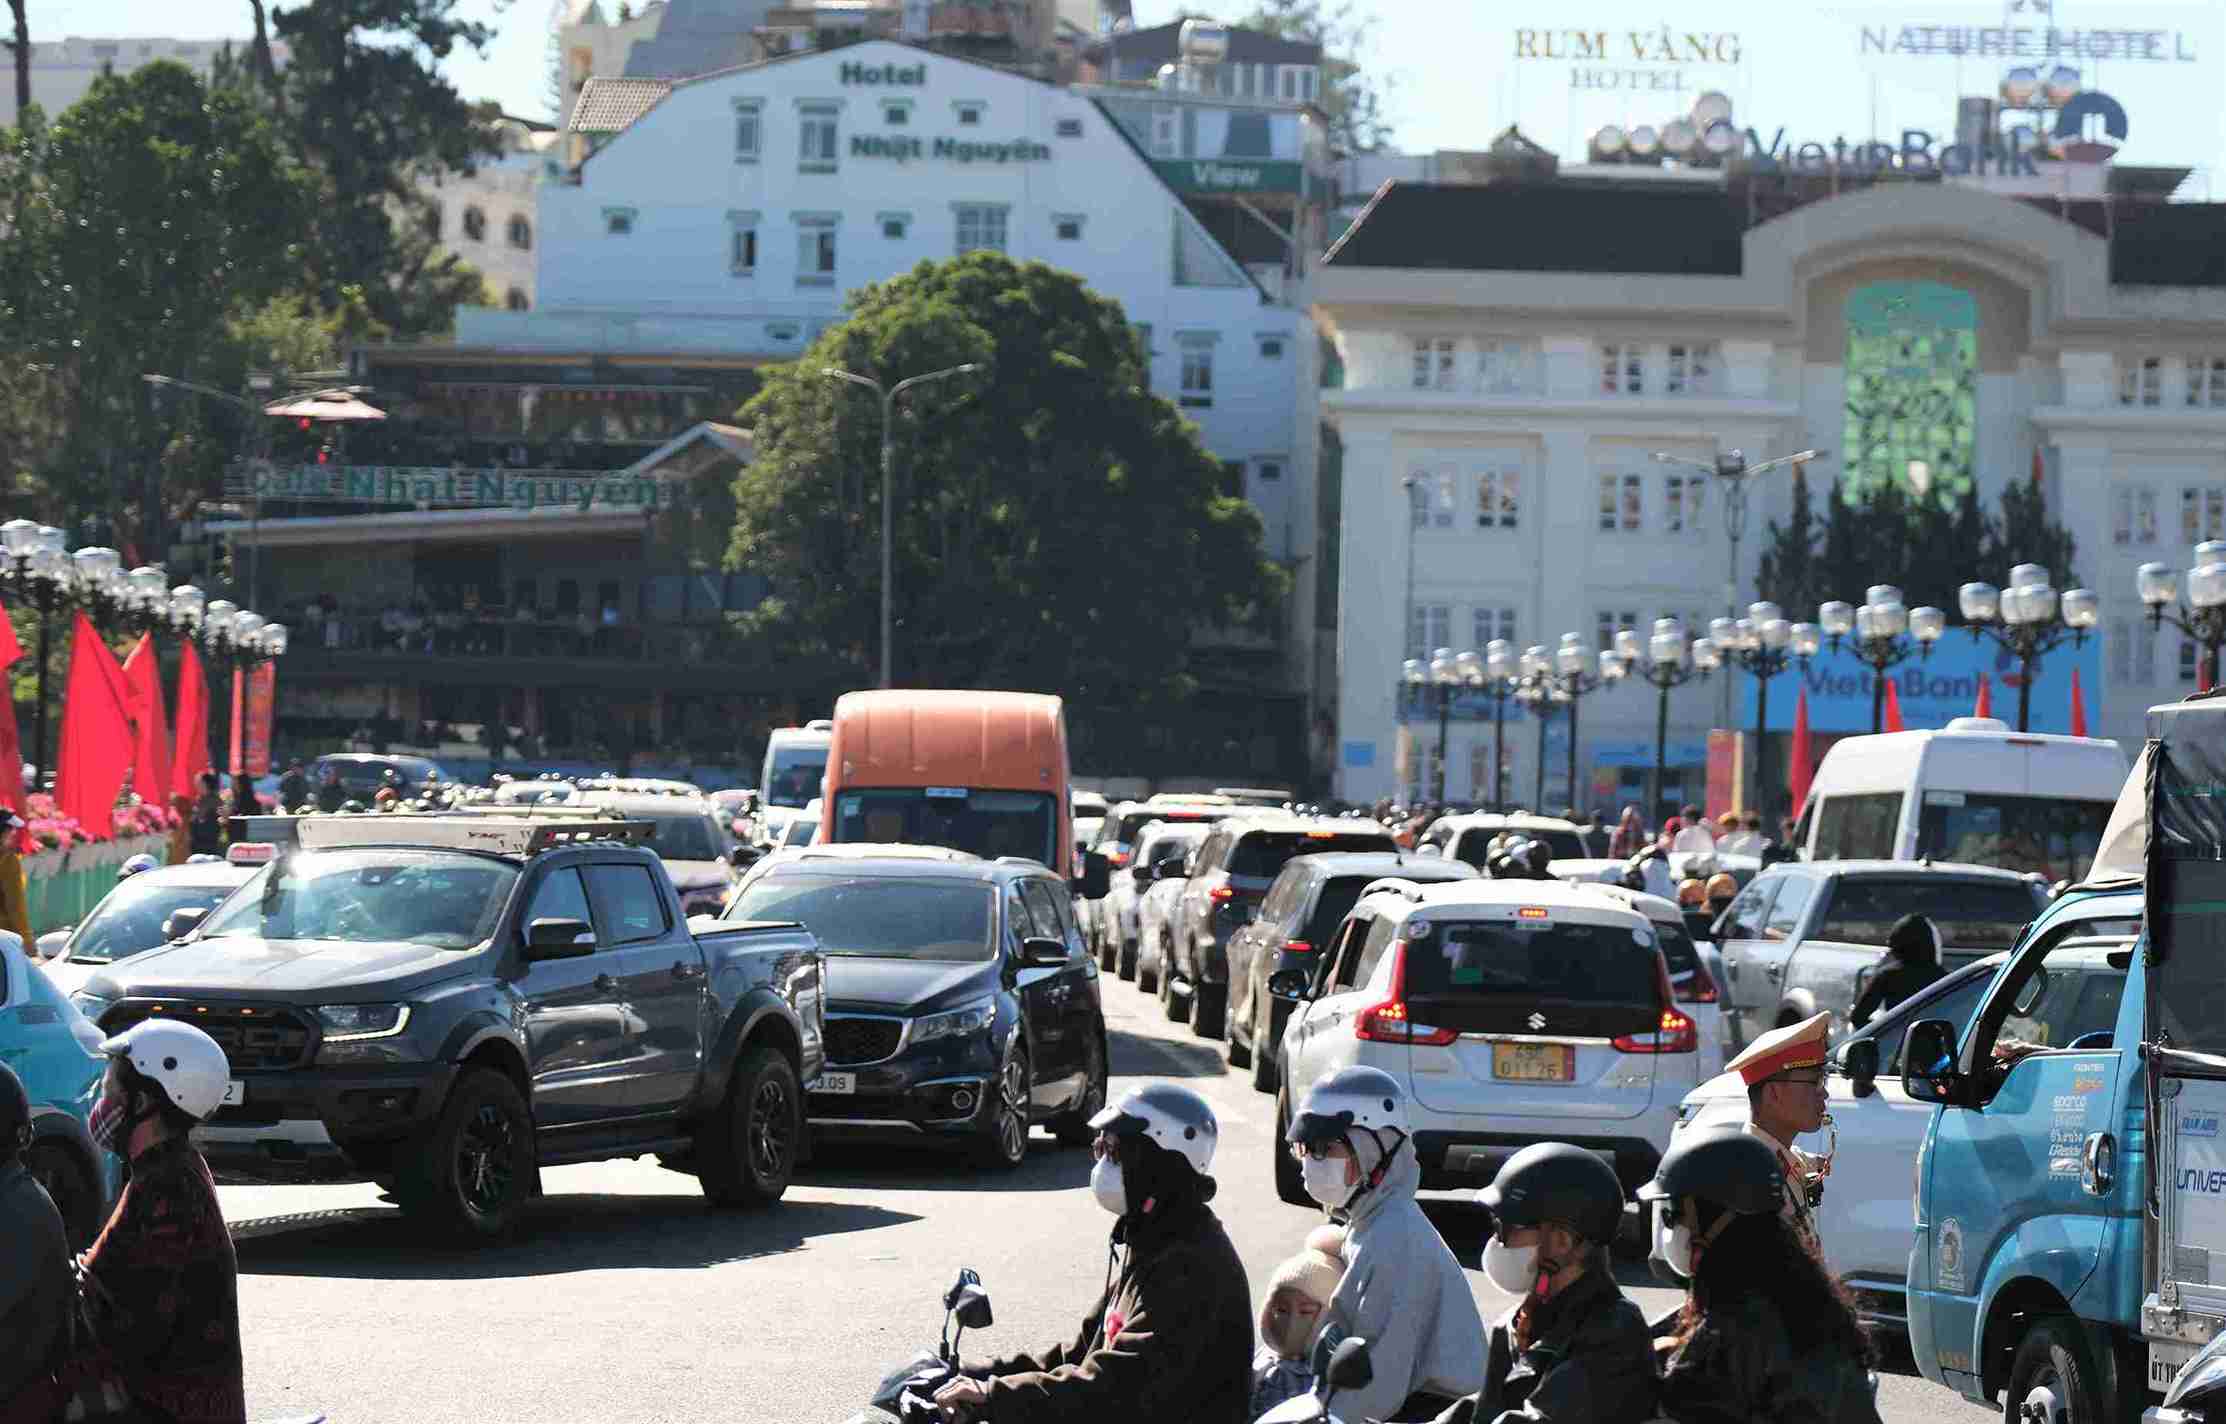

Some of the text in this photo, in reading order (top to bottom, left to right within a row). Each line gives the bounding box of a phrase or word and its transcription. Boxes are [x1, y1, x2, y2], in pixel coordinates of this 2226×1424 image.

[1514, 19, 1742, 64] RUM VÀNG
[1861, 25, 2197, 62] NATURE HOTEL
[841, 62, 927, 85] Hotel
[1569, 69, 1691, 91] HOTEL
[1192, 163, 1260, 185] View
